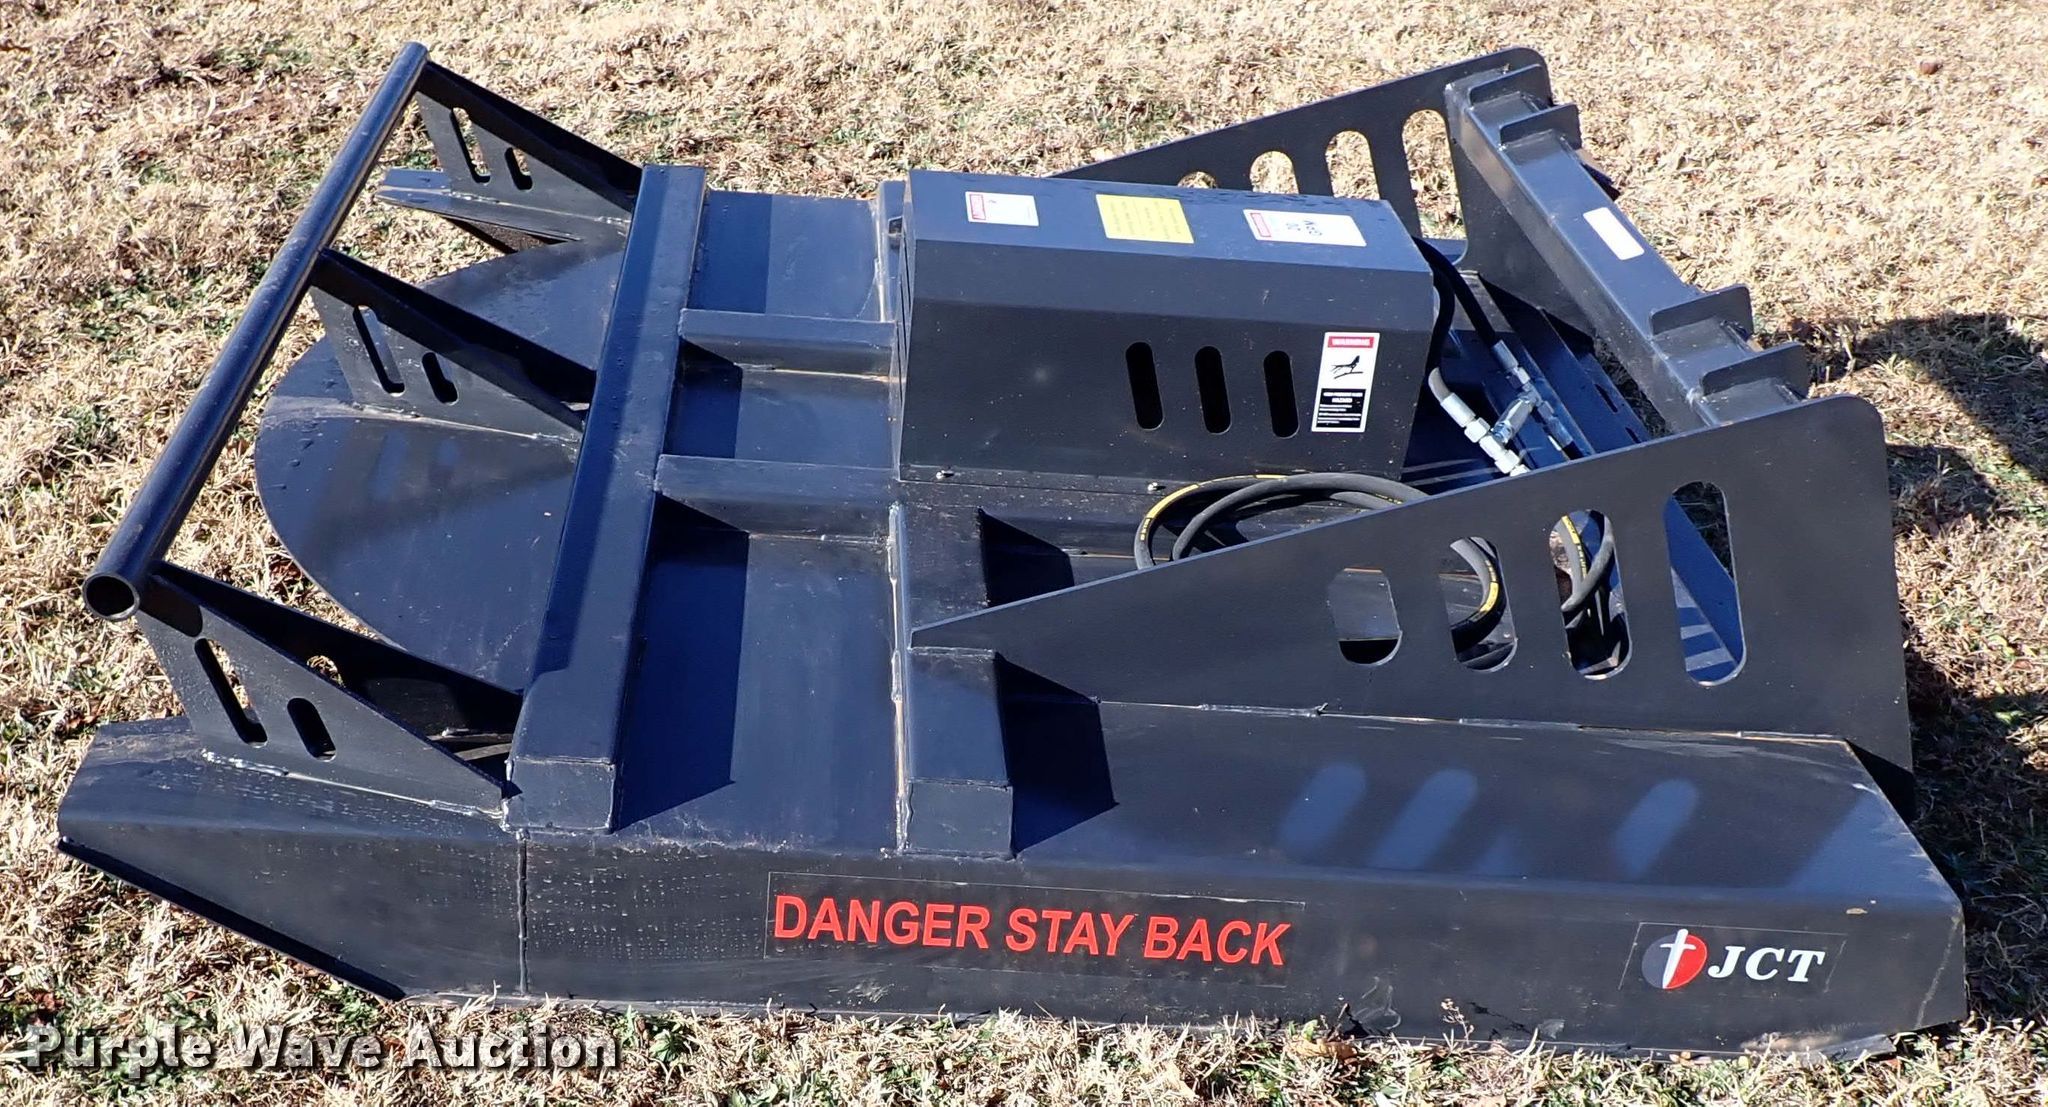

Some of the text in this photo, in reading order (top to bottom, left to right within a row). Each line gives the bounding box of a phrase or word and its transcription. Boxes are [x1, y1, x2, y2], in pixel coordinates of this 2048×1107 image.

[774, 894, 1290, 966] DANGER STAY BACK
[1707, 945, 1826, 983] JCT
